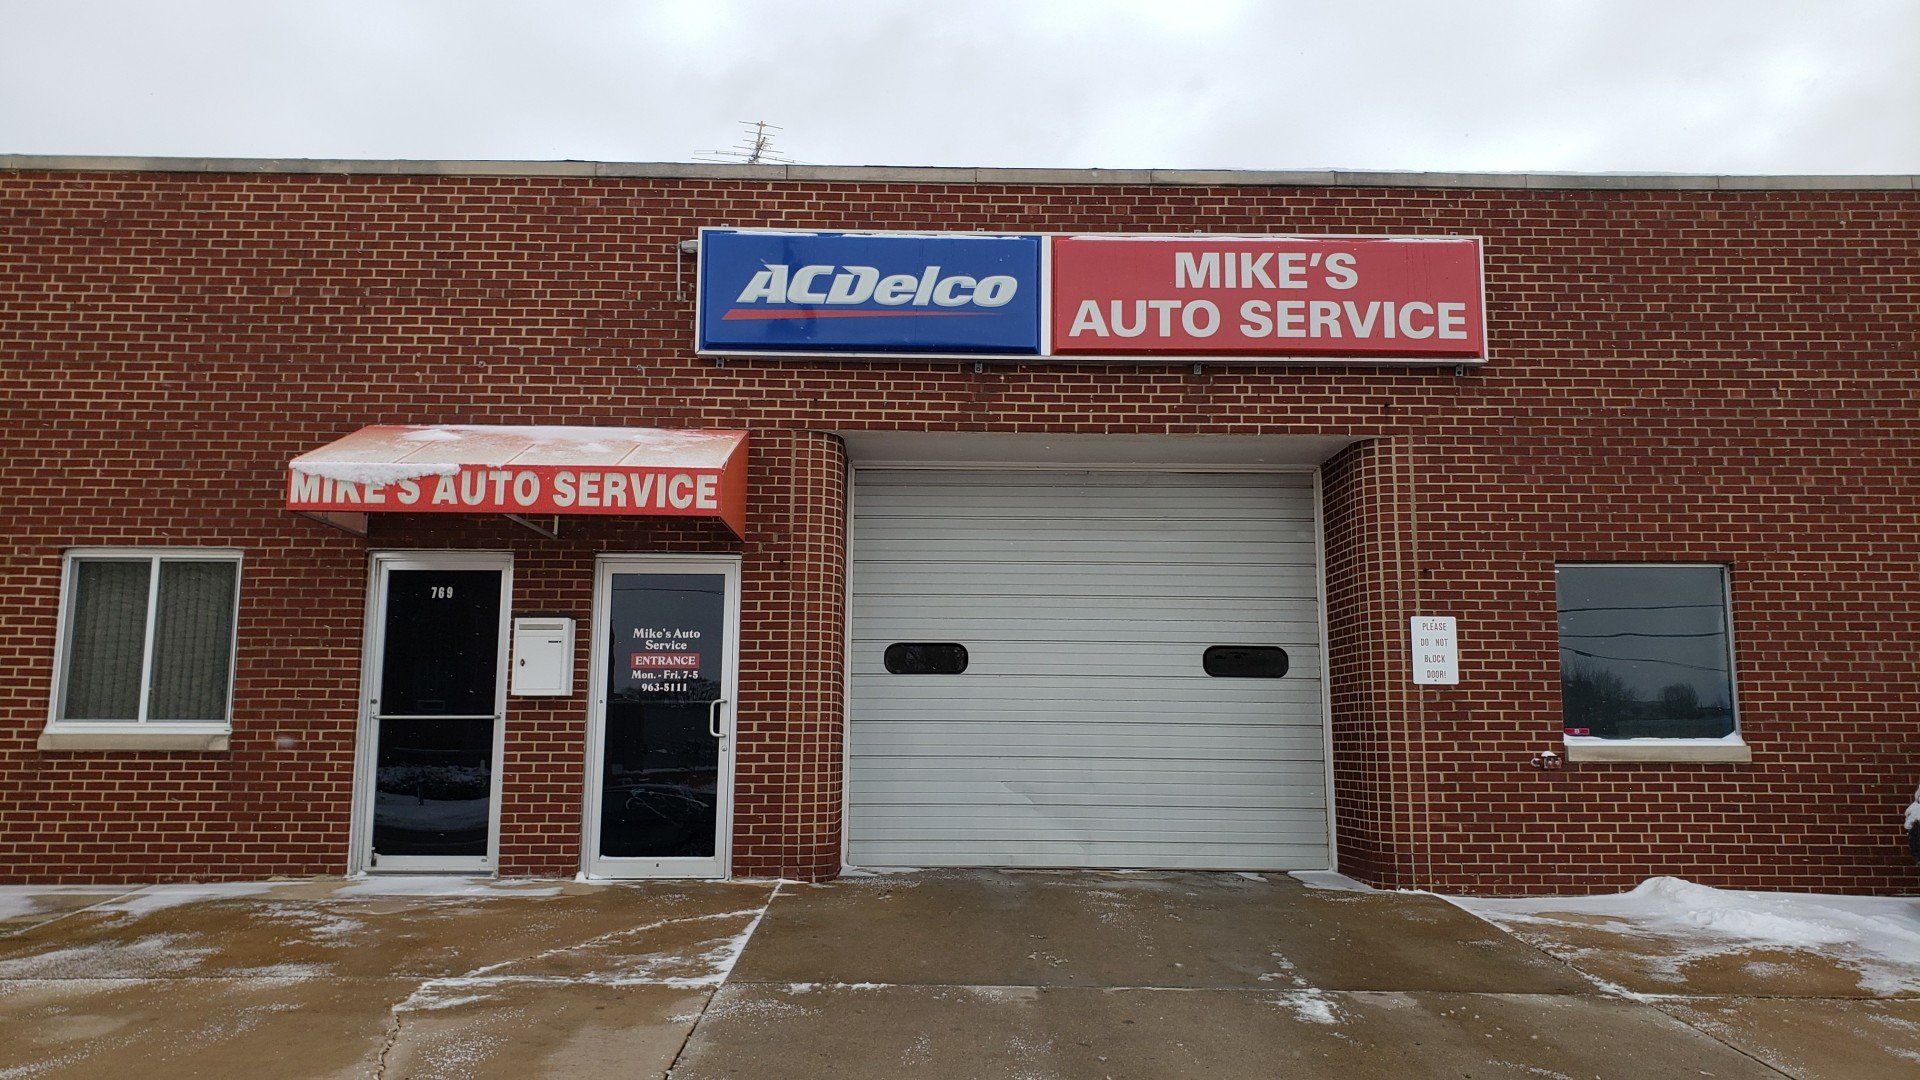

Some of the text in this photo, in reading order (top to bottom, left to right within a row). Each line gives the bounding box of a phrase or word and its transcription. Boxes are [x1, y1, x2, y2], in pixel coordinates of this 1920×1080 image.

[1174, 252, 1359, 290] MIKE'S
[736, 263, 1018, 308] ACDelco
[1068, 299, 1468, 340] AUTO SERVICE
[289, 469, 719, 509] MIKES AUTO SERVICE
[431, 586, 454, 599] 769
[1422, 622, 1447, 631] PLEASE
[633, 628, 701, 639] Mike's Auto
[645, 640, 687, 650] Service
[1420, 638, 1449, 647] DO NOT
[635, 656, 696, 666] ENTRANCE
[1424, 654, 1446, 663] BLOCK
[631, 670, 656, 679] Mon.
[663, 670, 681, 679] Fri.
[683, 670, 699, 679] 7-5
[1426, 669, 1447, 679] DOOR!
[641, 683, 688, 692] 963-5111
